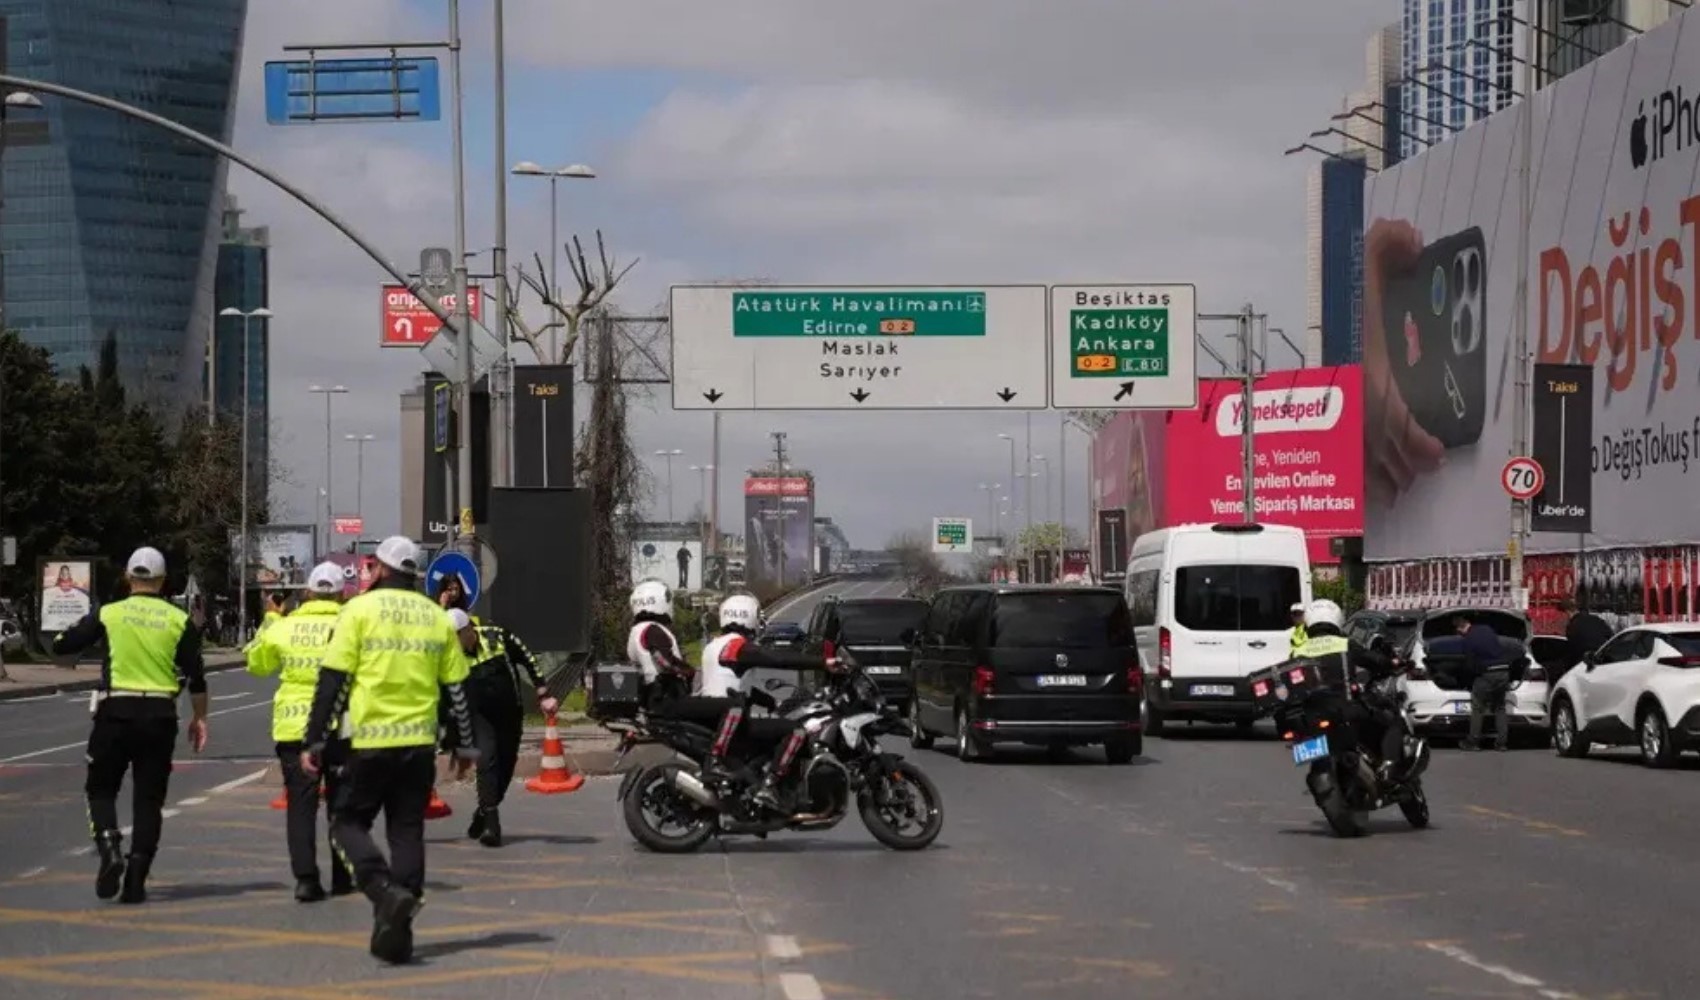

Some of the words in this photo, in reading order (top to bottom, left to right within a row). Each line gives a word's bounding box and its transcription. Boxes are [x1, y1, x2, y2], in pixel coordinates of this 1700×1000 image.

[736, 297, 821, 312] Atatürk
[831, 297, 962, 312] Havalimanı
[1076, 291, 1170, 307] Beşiktaş
[803, 319, 868, 334] Edirne
[1075, 314, 1164, 332] Kadıköy
[823, 341, 898, 355] Maslak
[1077, 336, 1154, 350] Ankara
[820, 362, 902, 381] Sarıyer
[528, 383, 559, 395] Taksi
[1547, 380, 1579, 393] Taksi
[1272, 449, 1321, 466] Yeniden
[1603, 421, 1690, 480] DeğişTokuş
[1225, 474, 1242, 491] En
[1292, 470, 1337, 488] Online
[1511, 468, 1536, 489] 70
[1210, 499, 1244, 515] Yeme
[1254, 495, 1298, 516] Sipariş
[1300, 493, 1356, 512] Markası
[1538, 504, 1587, 518] Uber'de
